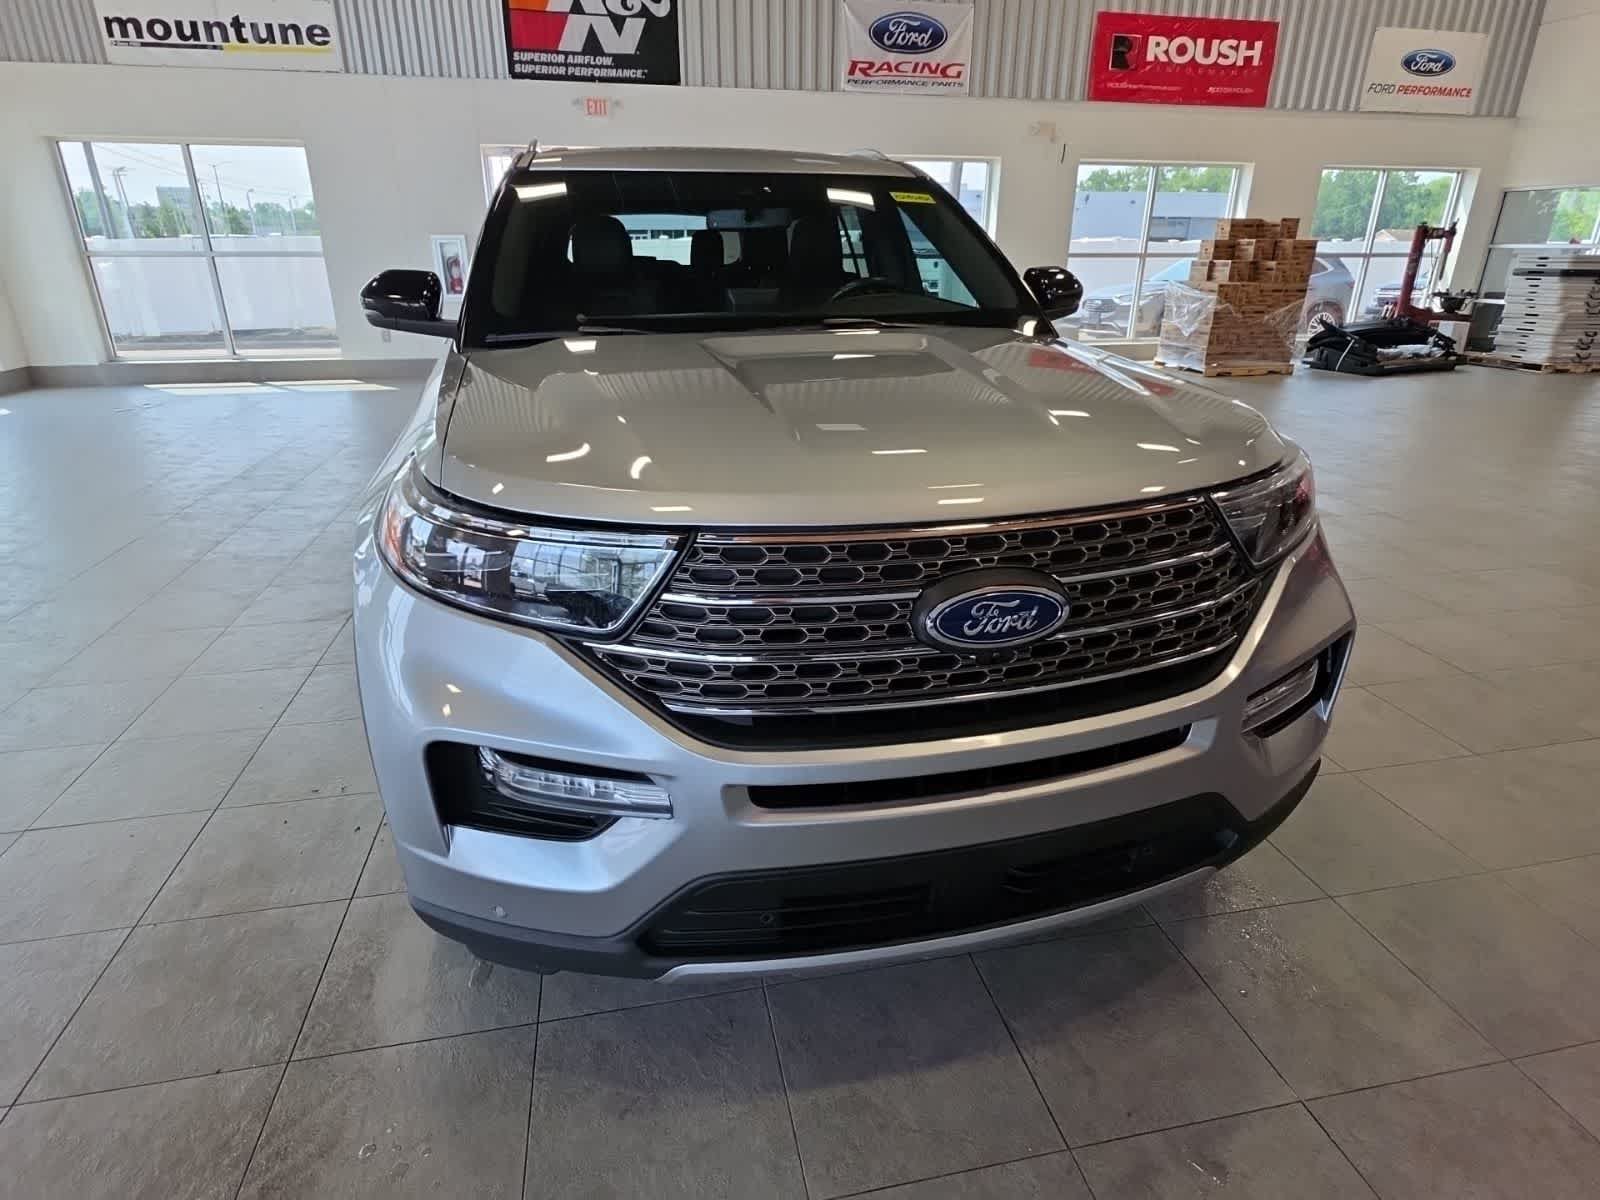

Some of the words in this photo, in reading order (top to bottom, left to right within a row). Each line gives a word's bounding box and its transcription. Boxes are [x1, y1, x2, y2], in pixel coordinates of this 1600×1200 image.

[103, 15, 331, 46] mountune
[884, 18, 933, 47] Ford
[513, 51, 565, 63] SUPERIOR
[567, 55, 615, 66] AIRFLOW.
[1146, 35, 1263, 66] ROUSH
[514, 63, 566, 75] SUPERIOR
[847, 60, 965, 79] RACING
[1411, 52, 1444, 72] Ford
[847, 79, 929, 87] PERFORMANCE
[931, 80, 964, 88] PARTS
[1367, 83, 1396, 95] FORD
[1396, 85, 1473, 98] PERFORMANCE
[963, 600, 1038, 636] Ford
